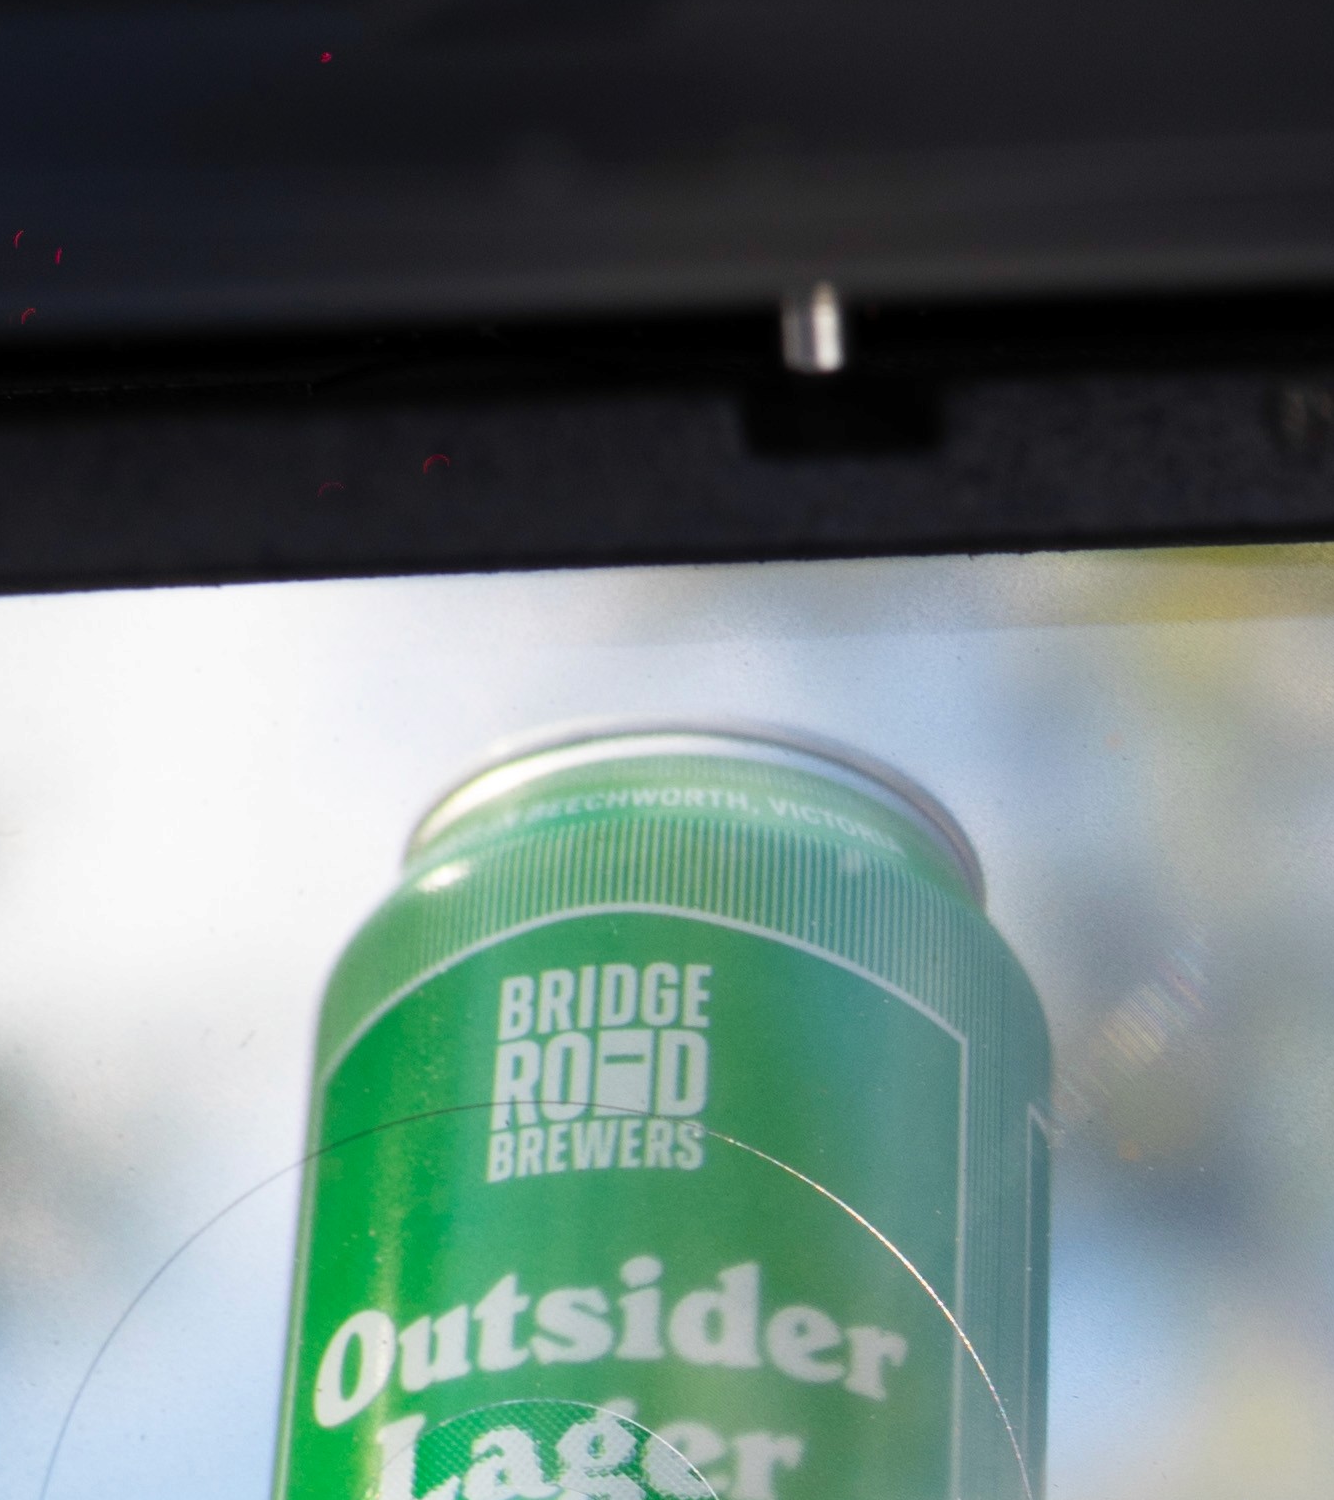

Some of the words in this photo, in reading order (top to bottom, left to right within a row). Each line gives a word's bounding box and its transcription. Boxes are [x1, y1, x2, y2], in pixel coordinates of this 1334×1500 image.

[497, 961, 713, 1042] BRIDGE
[485, 1117, 705, 1185] BREWERS
[313, 1254, 909, 1429] Outsider
